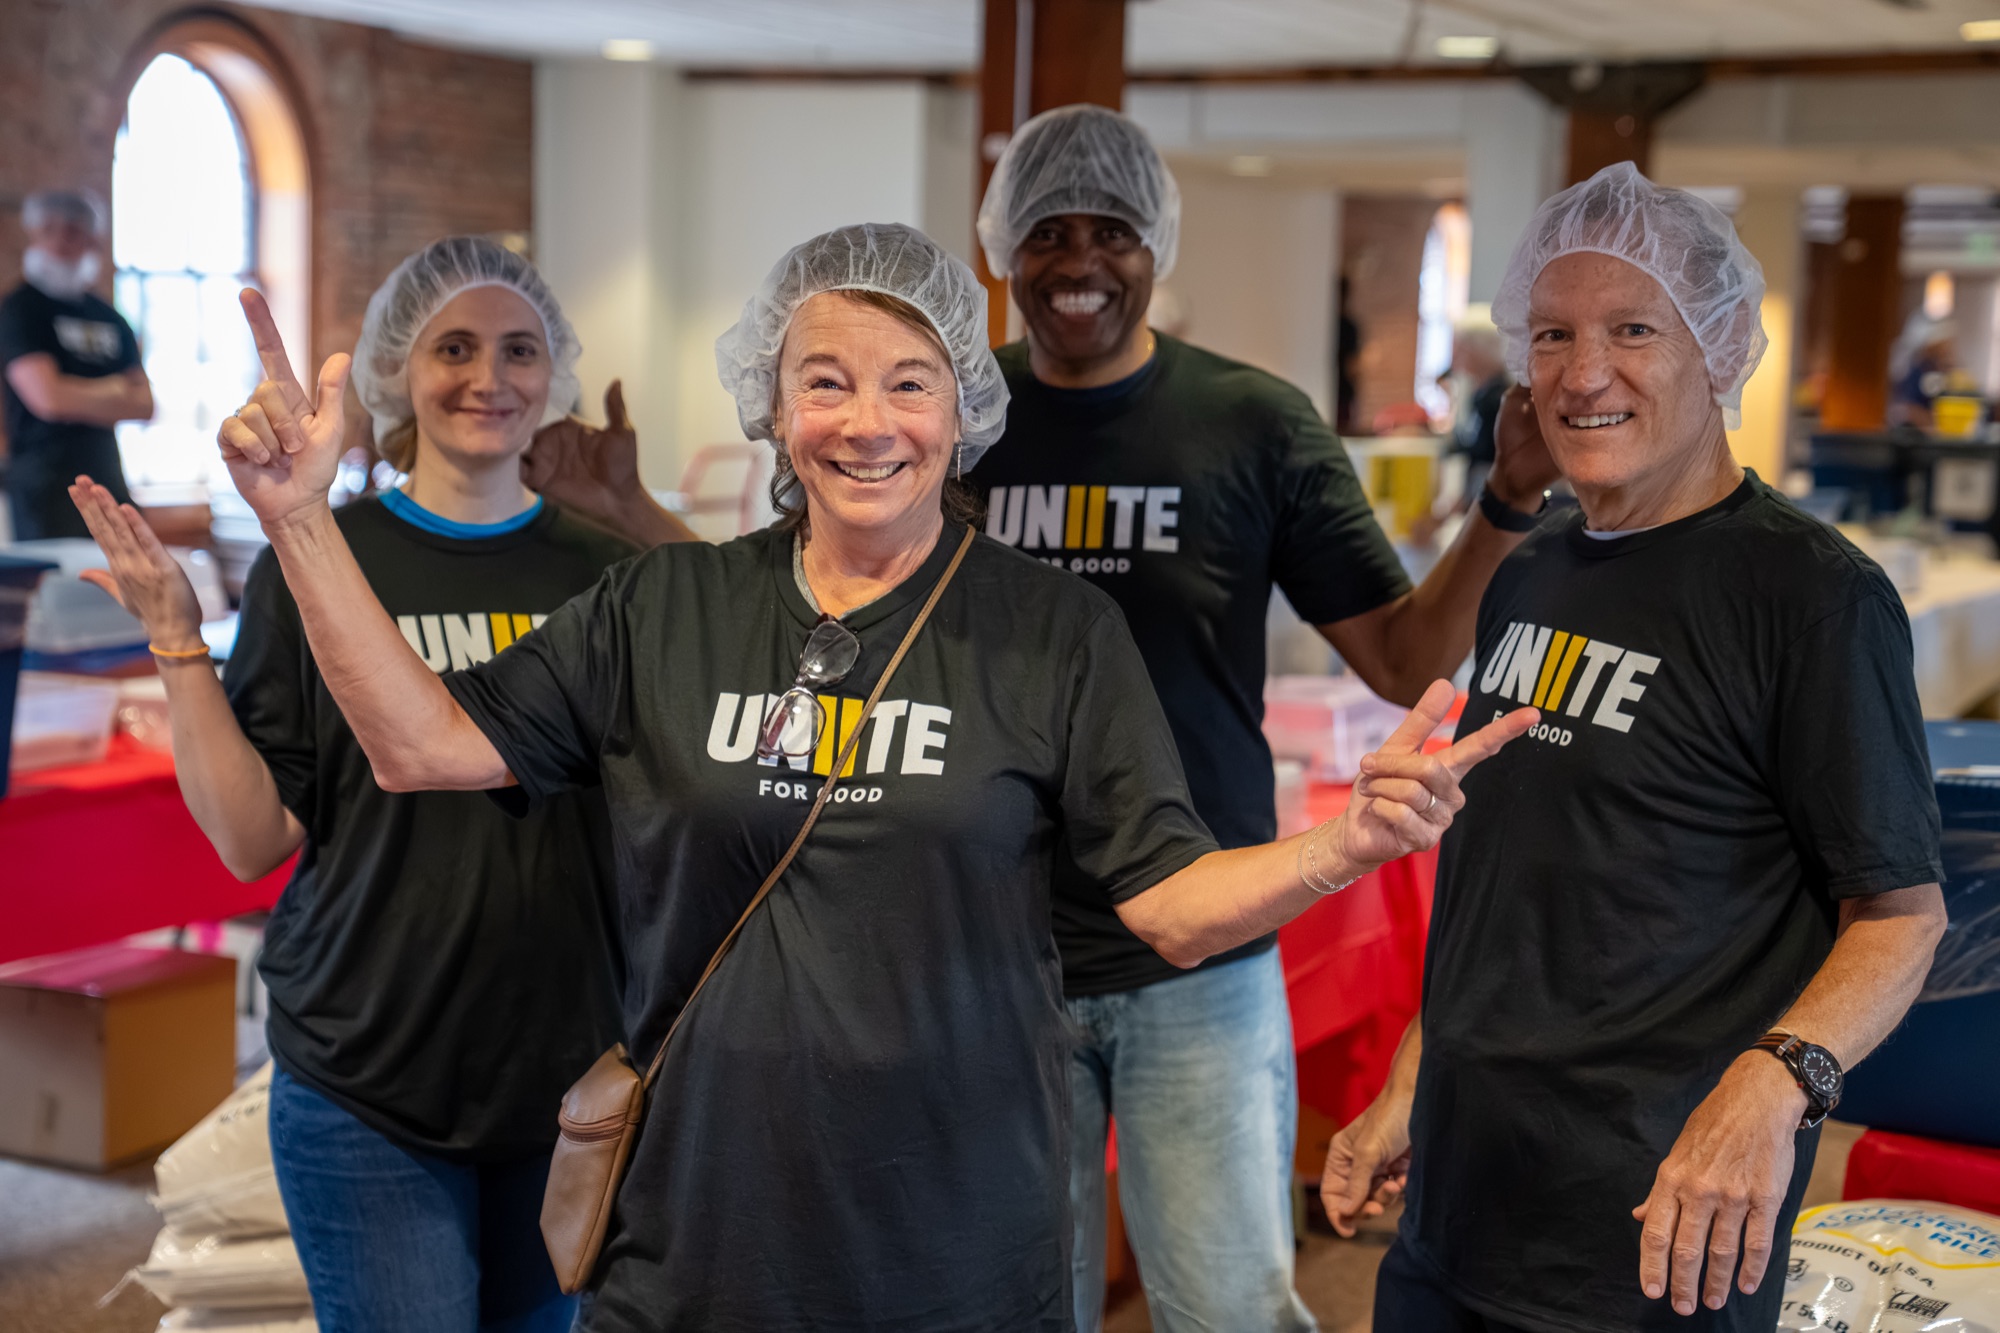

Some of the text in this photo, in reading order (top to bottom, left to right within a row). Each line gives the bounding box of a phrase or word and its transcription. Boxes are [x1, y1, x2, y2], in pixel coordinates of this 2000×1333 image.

[1070, 557, 1131, 574] GOOD
[1528, 723, 1573, 747] GOOD
[759, 779, 808, 800] FOR
[1792, 1239, 1865, 1260] RODUCT
